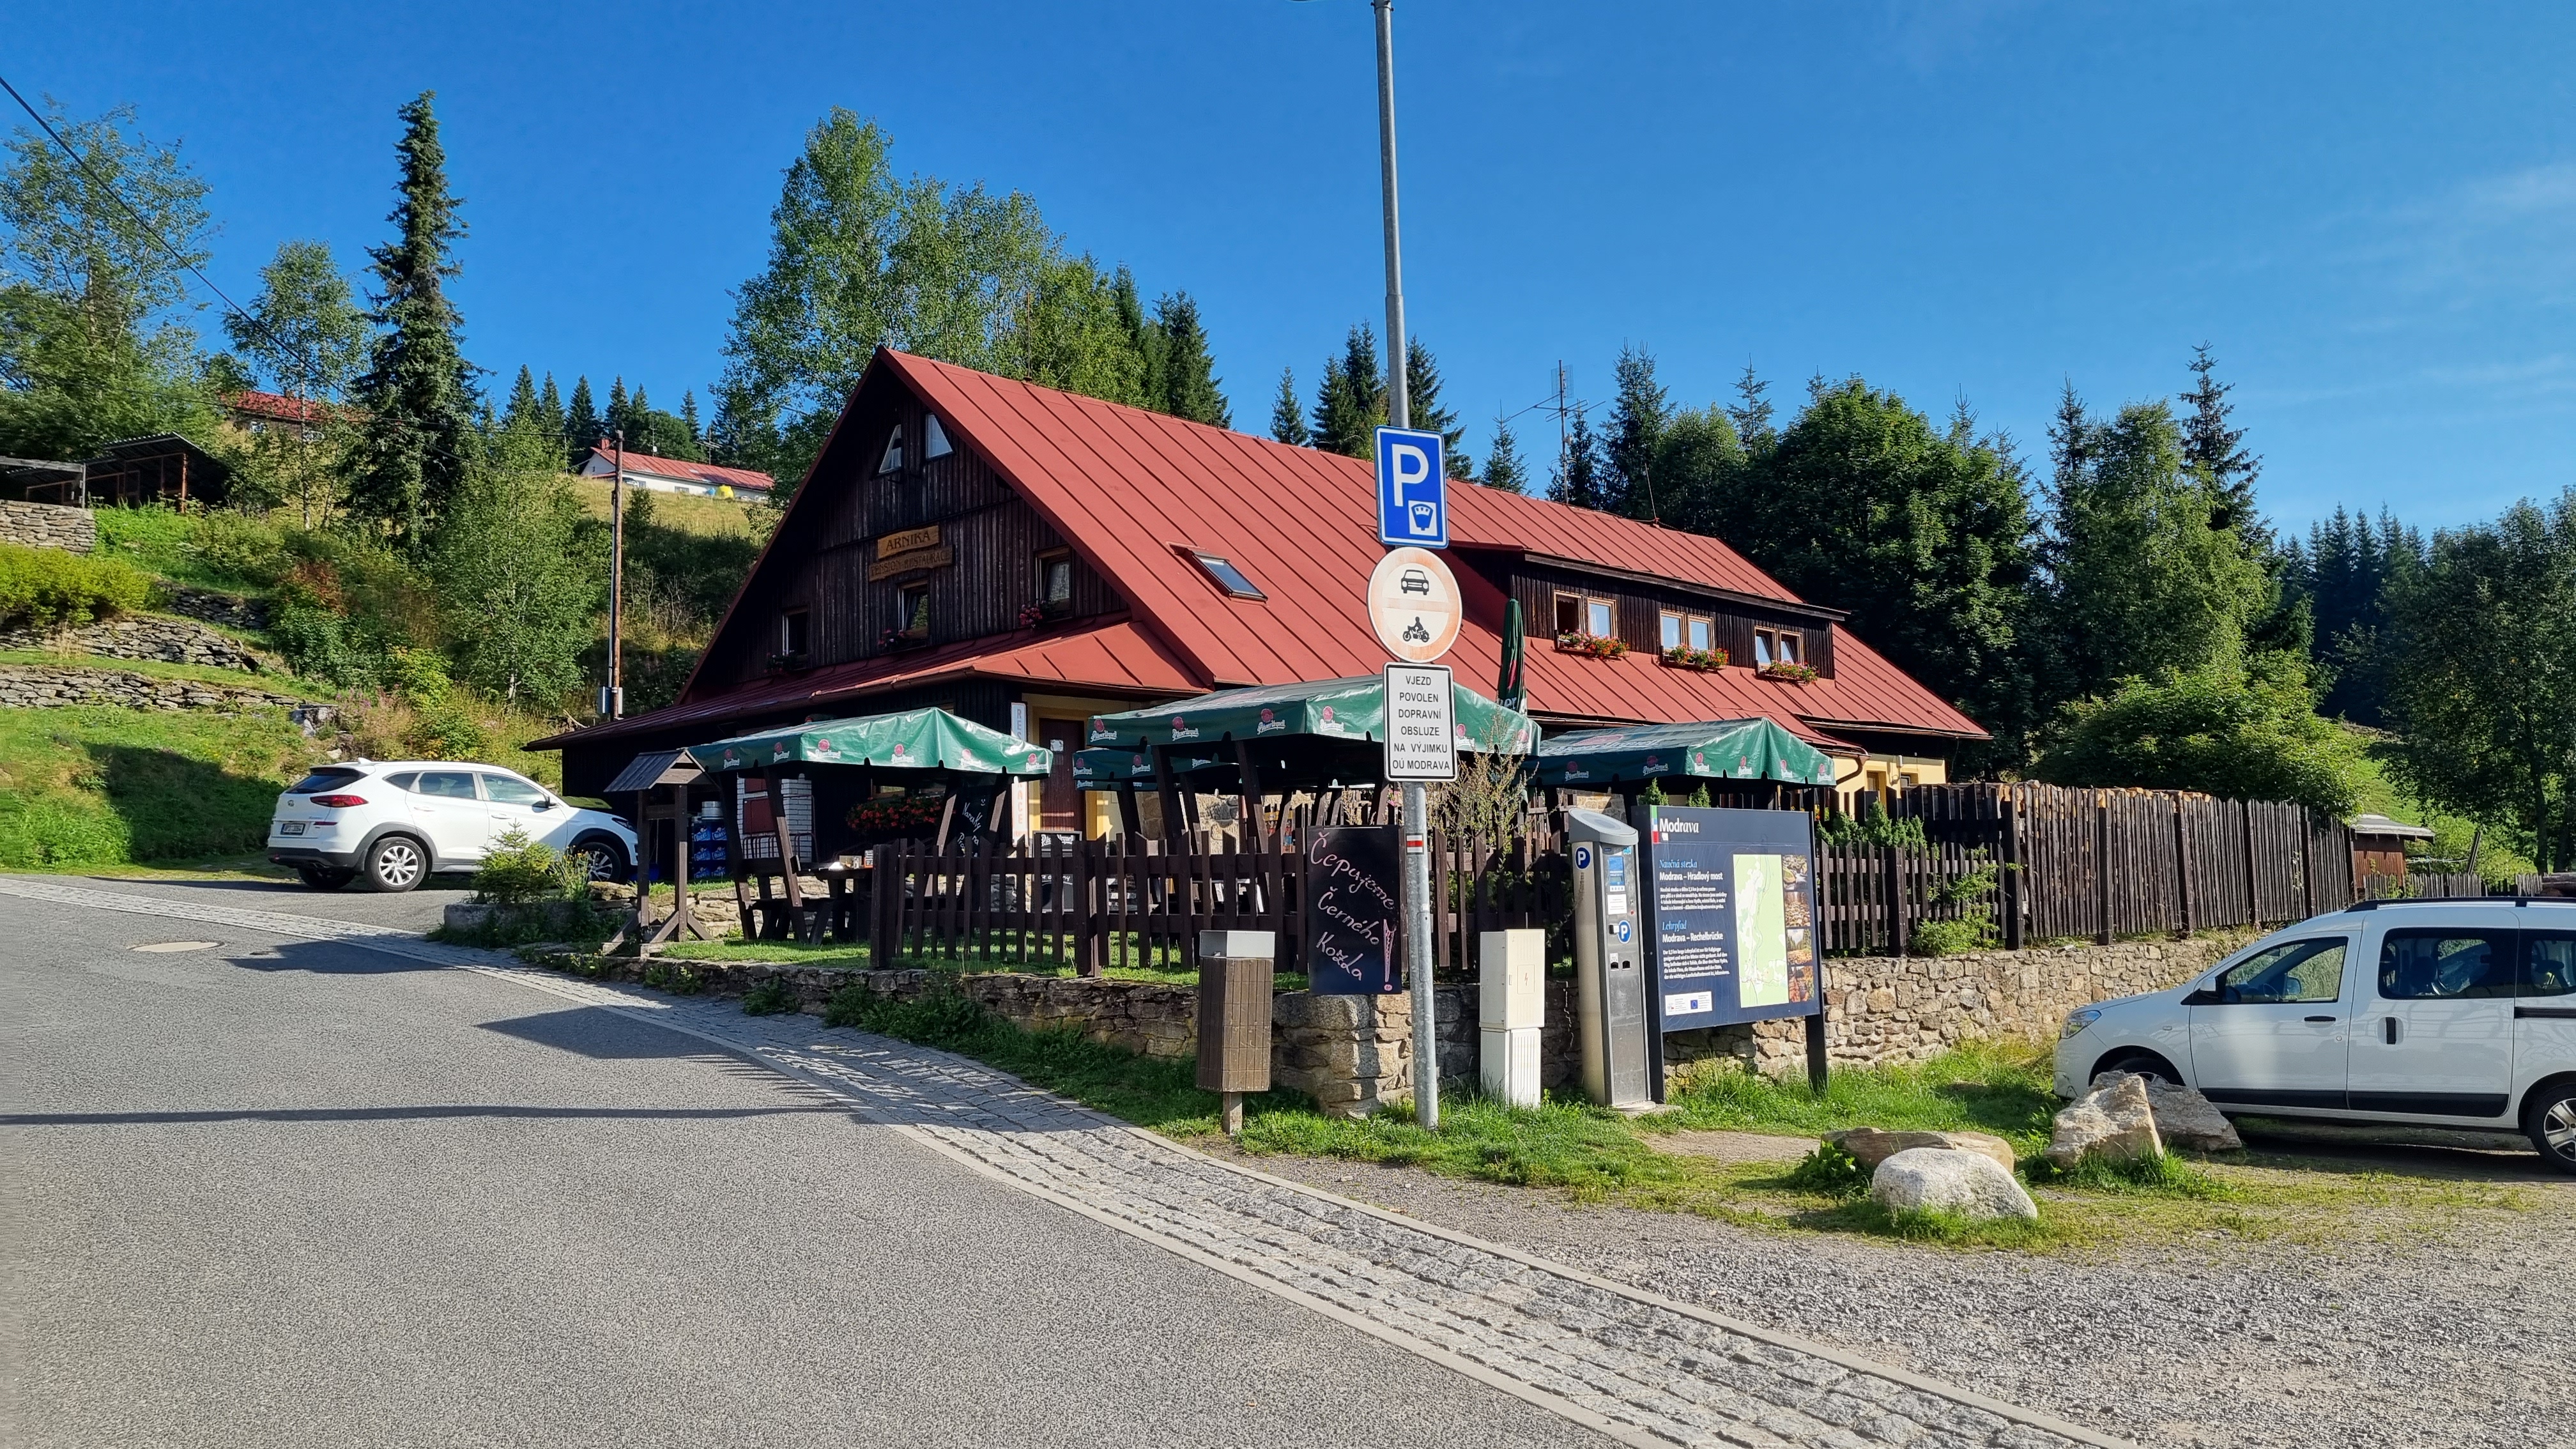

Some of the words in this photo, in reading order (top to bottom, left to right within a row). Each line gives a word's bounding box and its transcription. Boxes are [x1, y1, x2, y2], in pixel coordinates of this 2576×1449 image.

[1392, 443, 1429, 507] P
[885, 531, 930, 551] ARNIKA
[871, 560, 900, 576] PENSION
[1406, 675, 1431, 686] VJEZD
[1399, 692, 1439, 703] POVOLEN
[1399, 709, 1442, 719] DOPRAVNÍ
[1400, 726, 1440, 736] OBSLUZE
[1394, 743, 1406, 752] NA
[1411, 741, 1448, 753] VÝJIMKU
[1392, 758, 1405, 769] OÚ
[1407, 760, 1450, 770] MODRAVA
[1660, 817, 1699, 832] Modrava
[1577, 851, 1586, 865] P
[1680, 859, 1698, 868] stezka
[1310, 832, 1395, 910] Čepujeme
[1659, 871, 1683, 880] Modrava
[1687, 871, 1710, 882] Hradlový
[1710, 872, 1724, 880] most
[1317, 886, 1379, 945] Černého
[1621, 925, 1628, 939] P
[1662, 920, 1687, 932] Lehrpfad
[1662, 933, 1686, 943] Modrava
